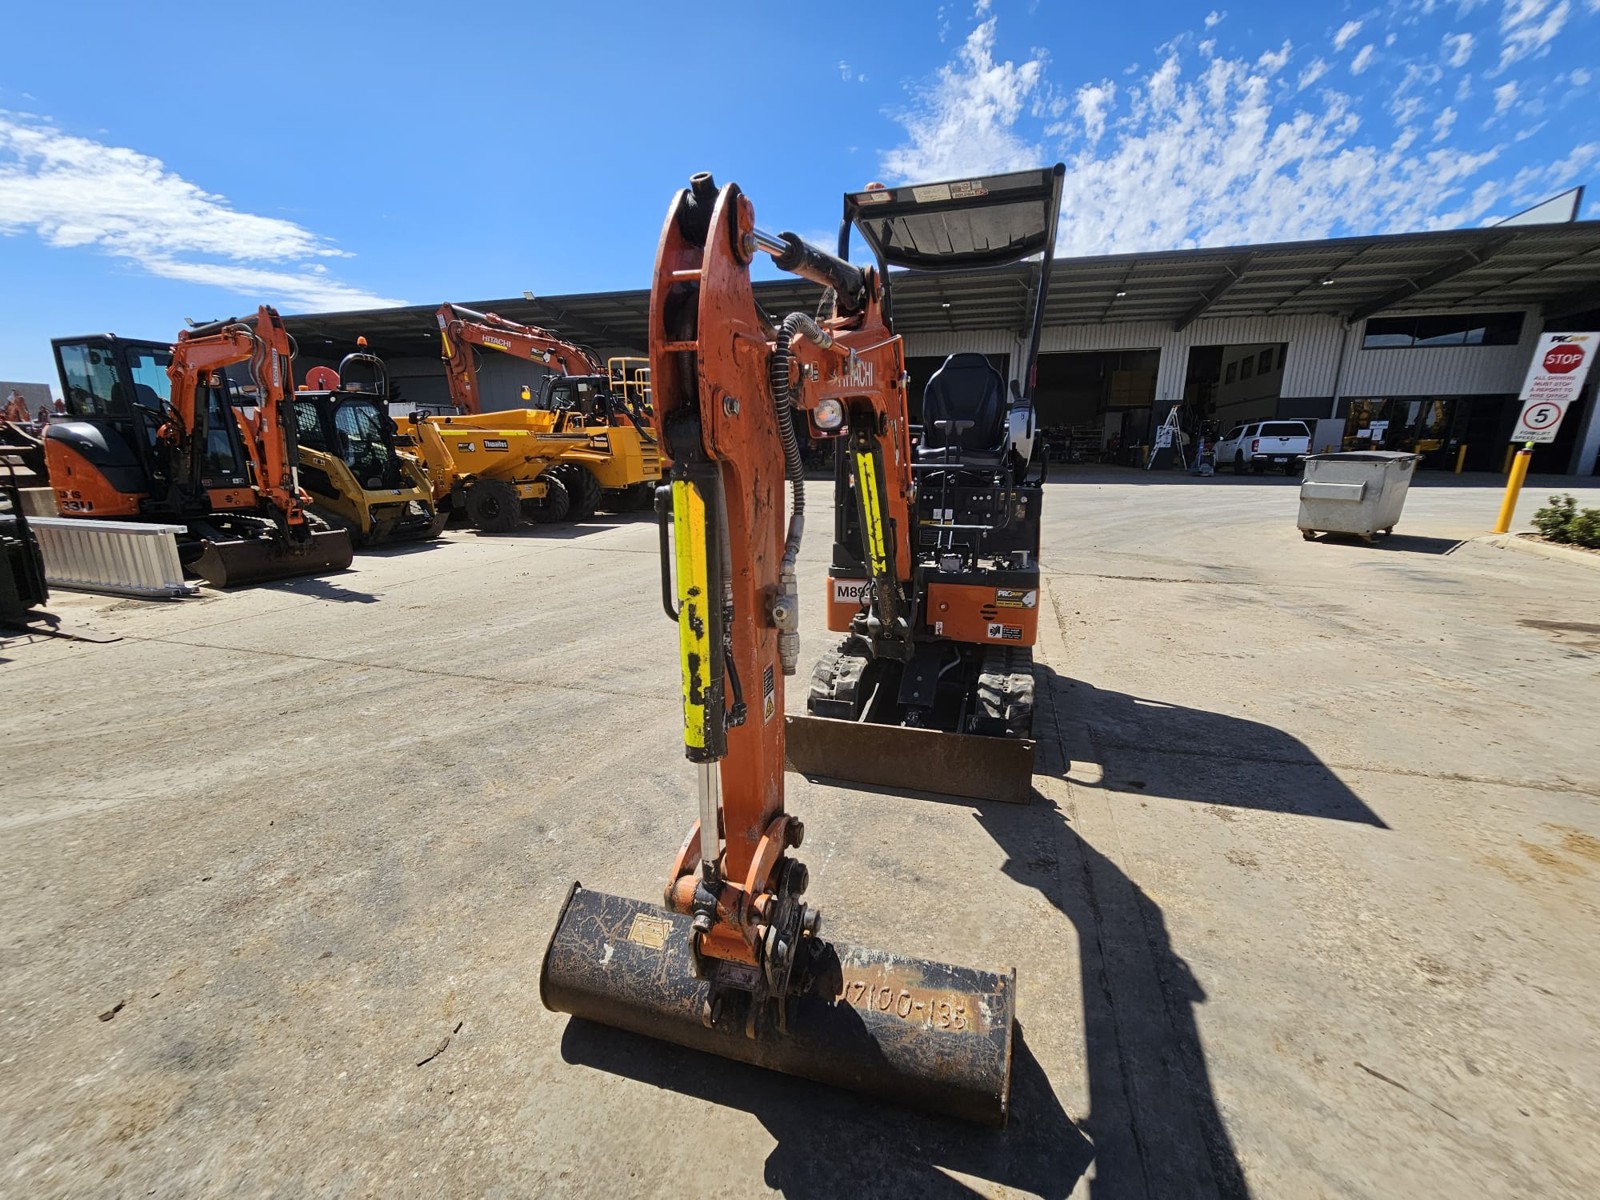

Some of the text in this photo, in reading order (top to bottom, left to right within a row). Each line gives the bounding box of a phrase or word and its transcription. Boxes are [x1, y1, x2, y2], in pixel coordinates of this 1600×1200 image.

[482, 335, 512, 348] HITACHI
[1546, 353, 1582, 365] STOP
[1534, 409, 1550, 423] 5
